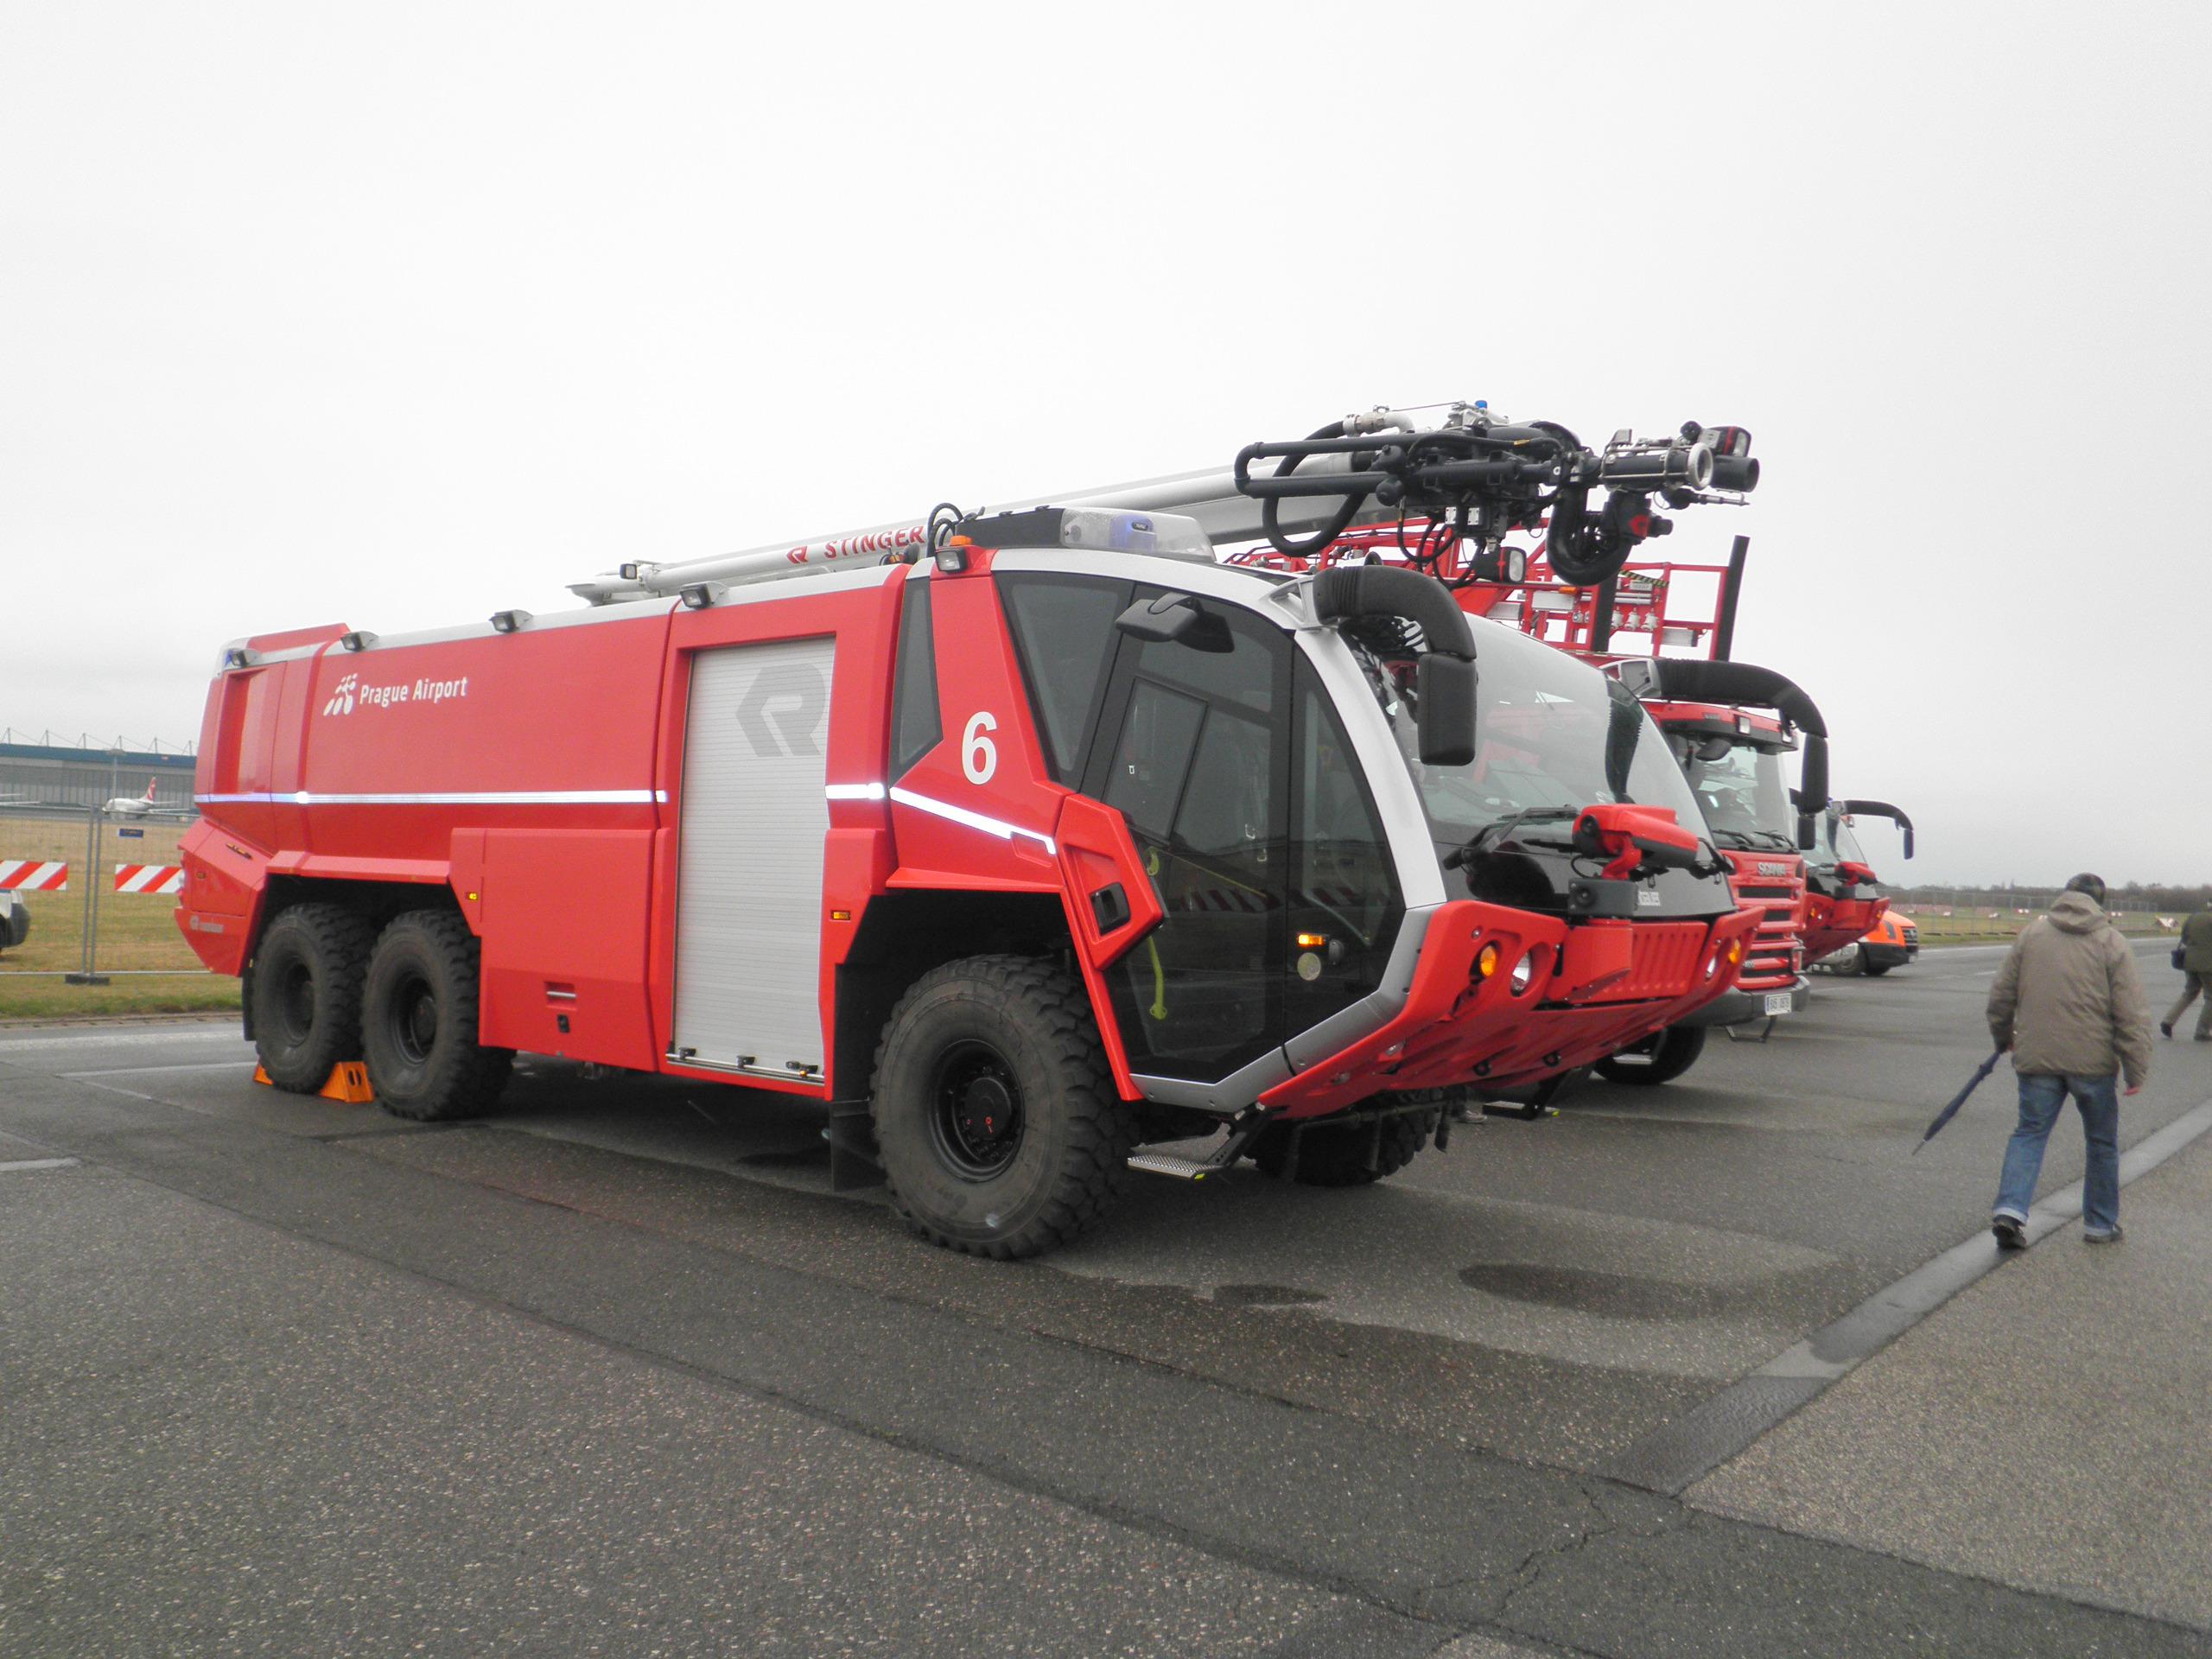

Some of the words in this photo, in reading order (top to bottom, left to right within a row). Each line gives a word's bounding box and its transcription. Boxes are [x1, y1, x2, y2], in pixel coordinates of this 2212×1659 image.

[823, 525, 925, 559] STINGER
[359, 684, 409, 708] Prague
[412, 677, 468, 703] Airport
[961, 710, 998, 785] 6
